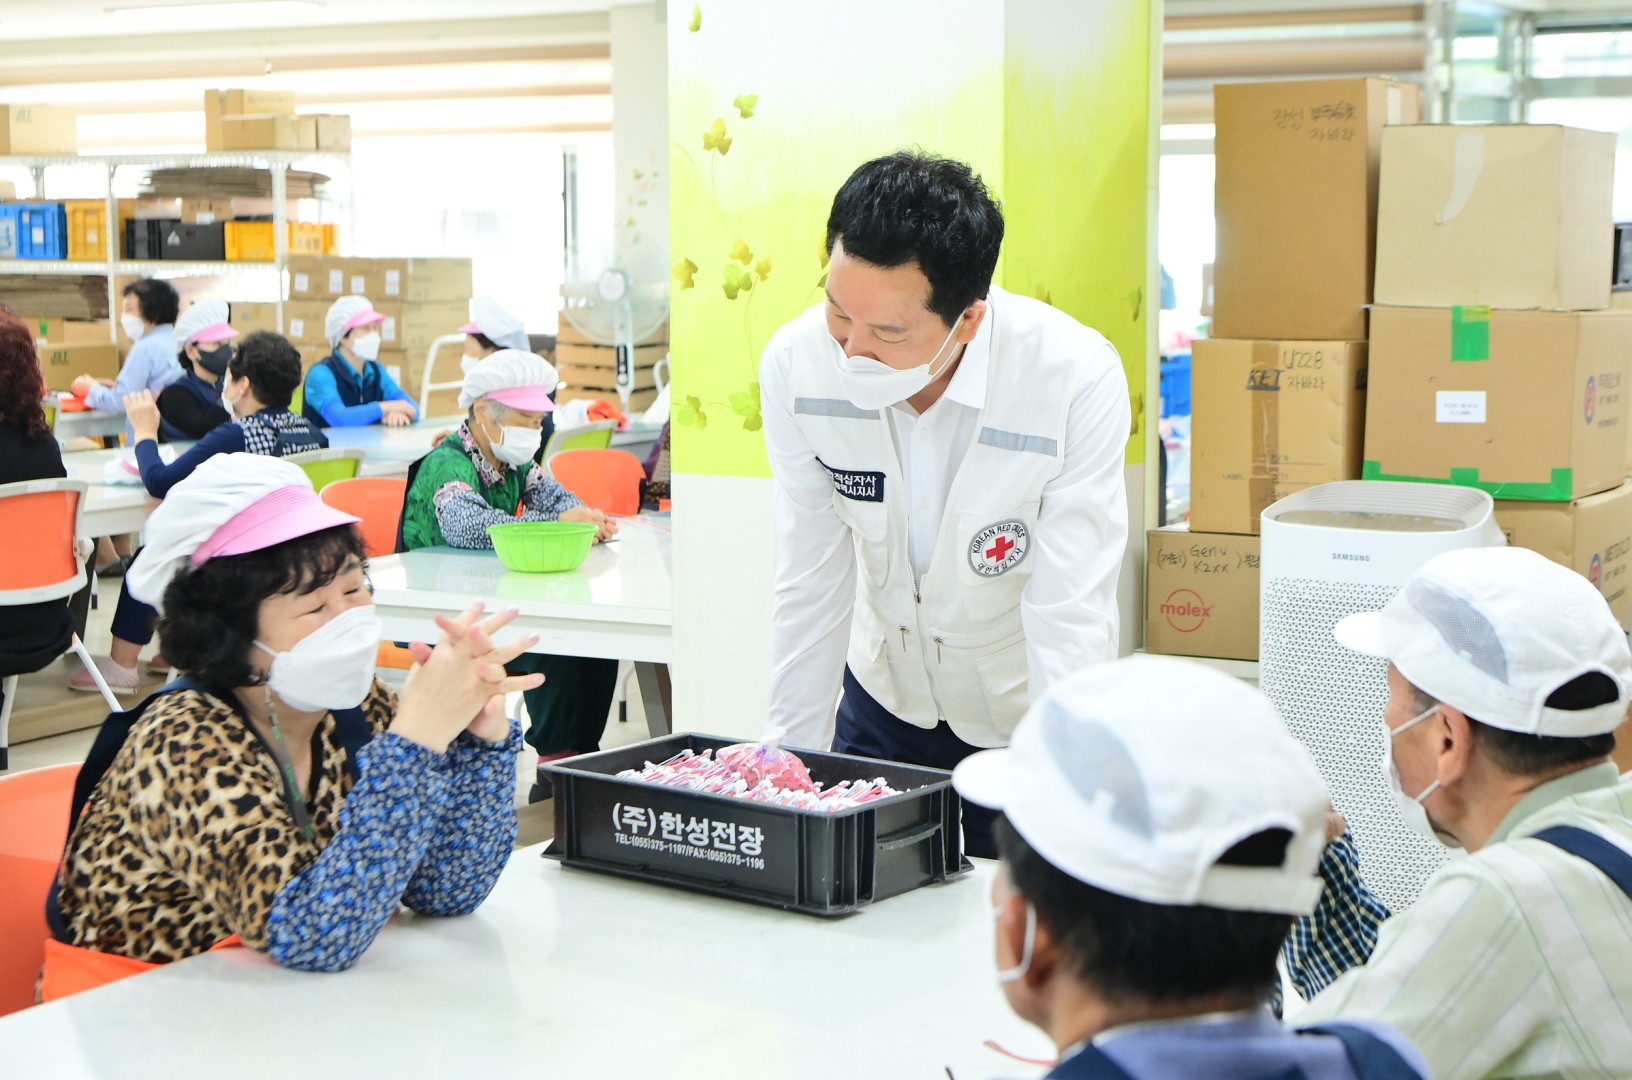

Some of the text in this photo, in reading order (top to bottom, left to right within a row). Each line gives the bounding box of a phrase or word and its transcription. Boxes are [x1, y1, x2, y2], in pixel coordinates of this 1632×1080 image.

[972, 528, 996, 554] KOREAN
[997, 524, 1011, 533] RED
[1332, 553, 1370, 562] SAMSUNG
[1160, 602, 1211, 618] molex
